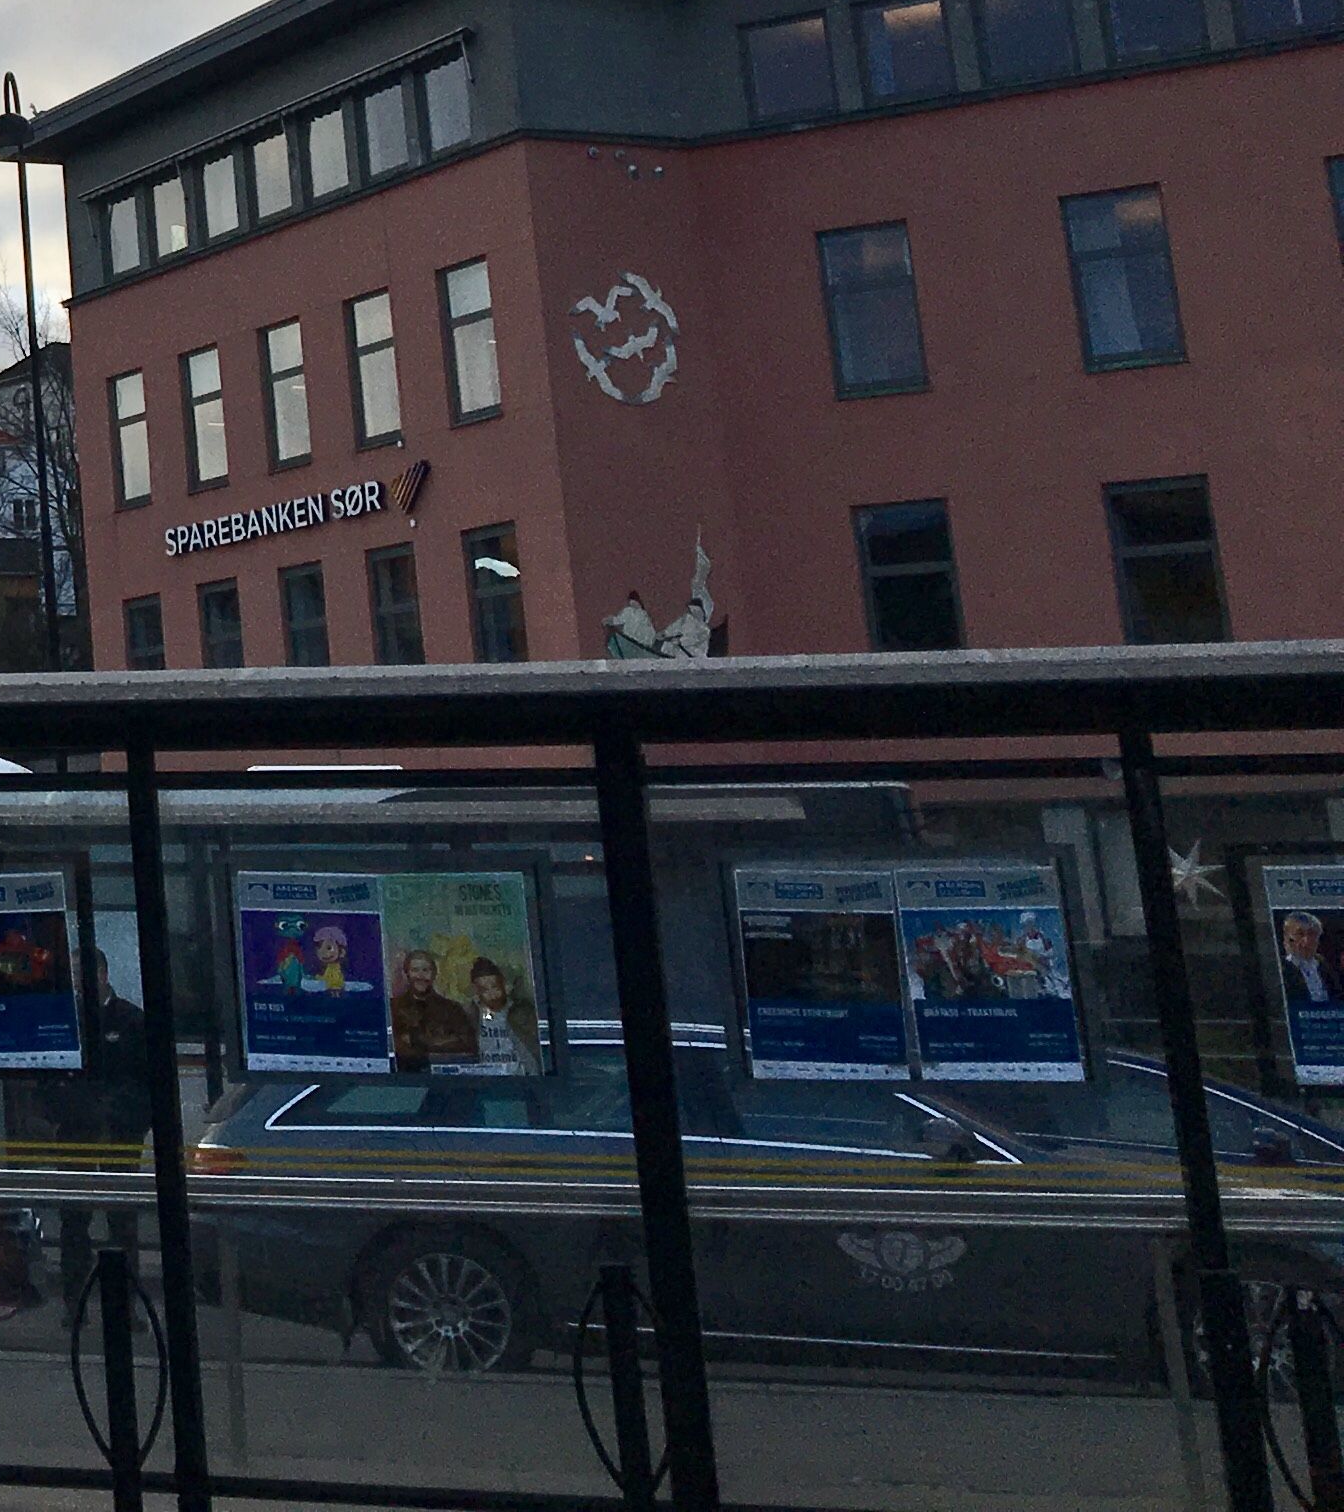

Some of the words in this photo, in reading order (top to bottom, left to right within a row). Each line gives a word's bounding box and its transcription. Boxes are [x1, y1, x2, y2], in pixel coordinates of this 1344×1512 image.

[165, 493, 324, 556] SPAREBANKEN
[331, 480, 382, 520] SØR
[459, 884, 502, 901] STONES
